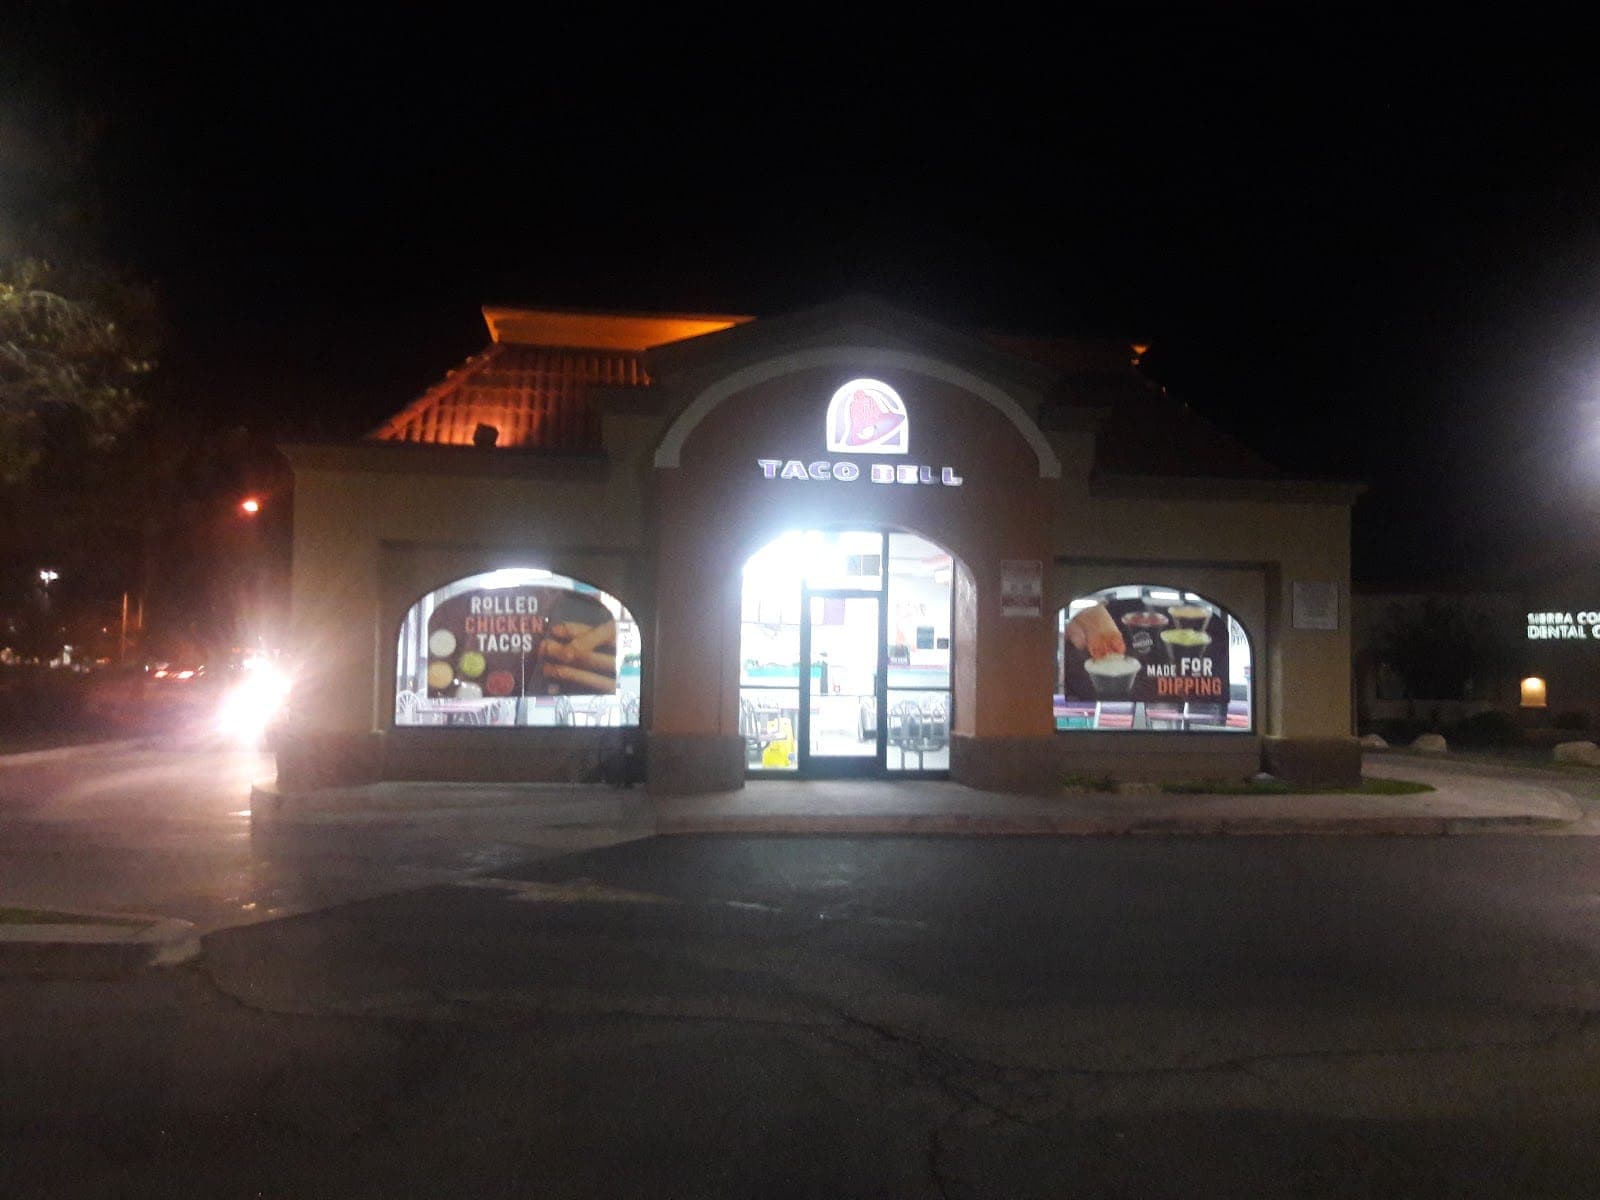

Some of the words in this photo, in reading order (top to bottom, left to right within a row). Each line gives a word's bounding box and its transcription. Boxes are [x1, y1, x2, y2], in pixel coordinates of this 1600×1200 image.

[757, 459, 859, 481] TACO
[871, 464, 963, 485] BELL
[471, 596, 538, 614] ROLLED
[464, 615, 544, 633] CHICKEN
[1577, 611, 1600, 625] CO
[1527, 625, 1587, 639] DENTAL
[478, 634, 532, 652] TACOS
[1147, 664, 1176, 676] MADE
[1181, 657, 1213, 676] FOR
[1157, 677, 1222, 696] DIPPING
